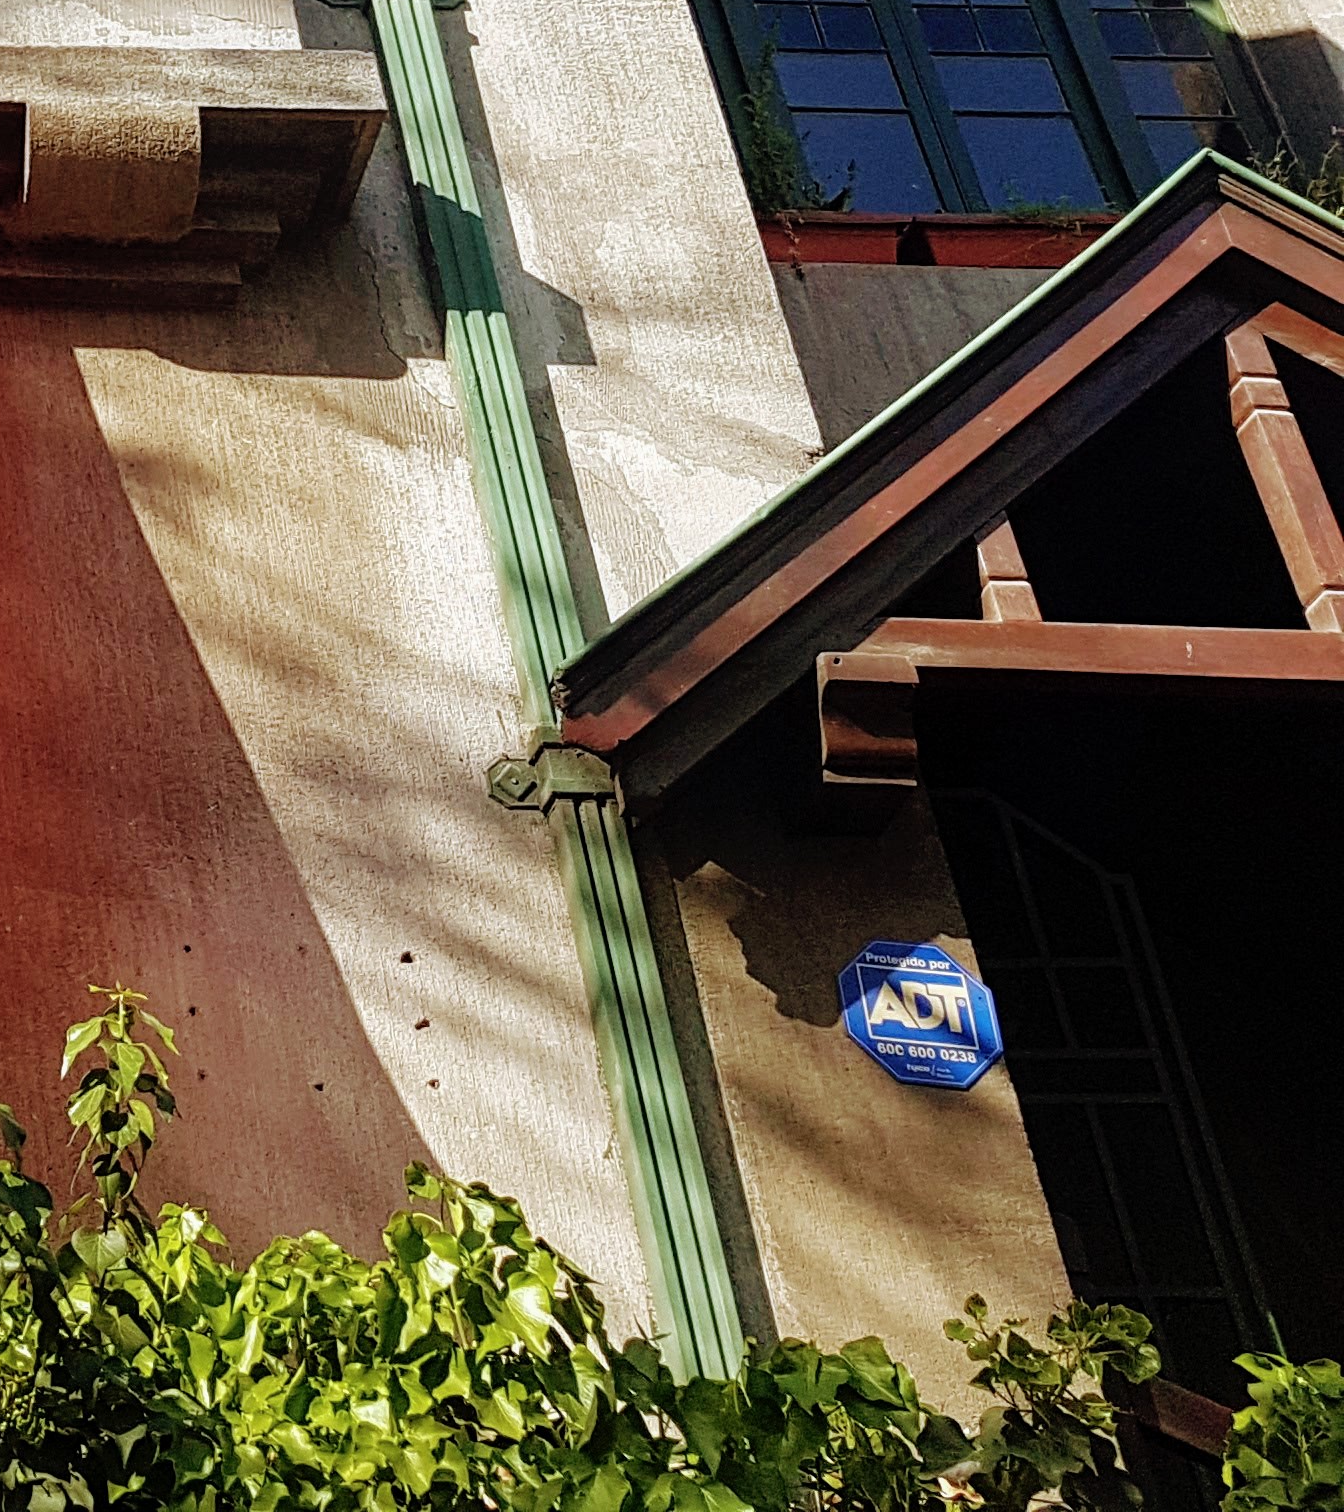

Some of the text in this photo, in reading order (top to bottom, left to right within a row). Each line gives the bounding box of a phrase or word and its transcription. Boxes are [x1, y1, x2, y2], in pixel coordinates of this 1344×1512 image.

[865, 952, 950, 970] Protegido por
[869, 980, 967, 1033] ADT
[908, 1045, 936, 1059] 600
[940, 1048, 977, 1064] 0238
